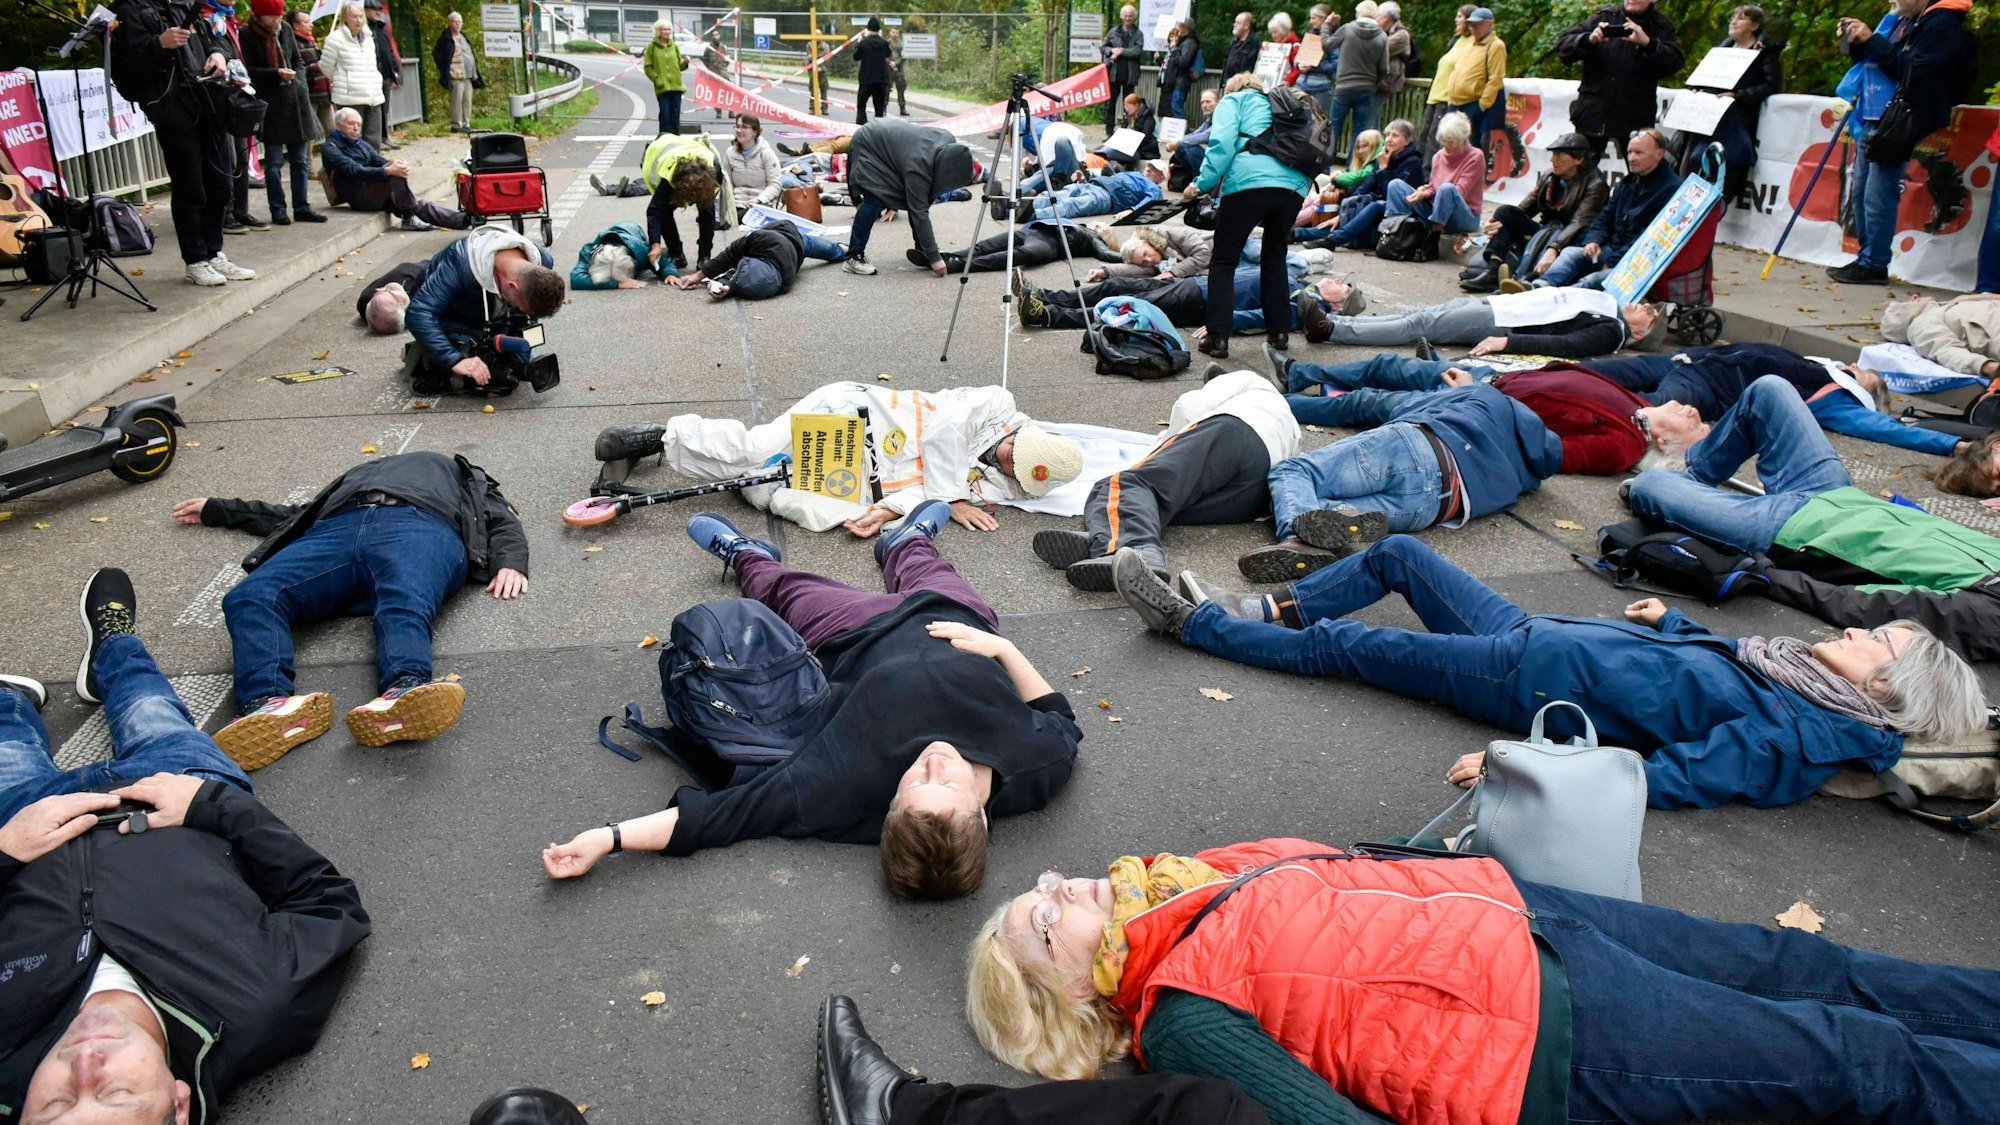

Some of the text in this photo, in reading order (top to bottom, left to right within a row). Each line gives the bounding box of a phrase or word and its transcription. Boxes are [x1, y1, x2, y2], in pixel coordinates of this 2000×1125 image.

[695, 84, 713, 100] Ob
[717, 89, 783, 118] EU-Armee
[800, 431, 813, 491] abschaffen!
[814, 430, 827, 492] Atomwaffen
[834, 429, 843, 462] mahnt:
[845, 420, 858, 468] Hiroshima
